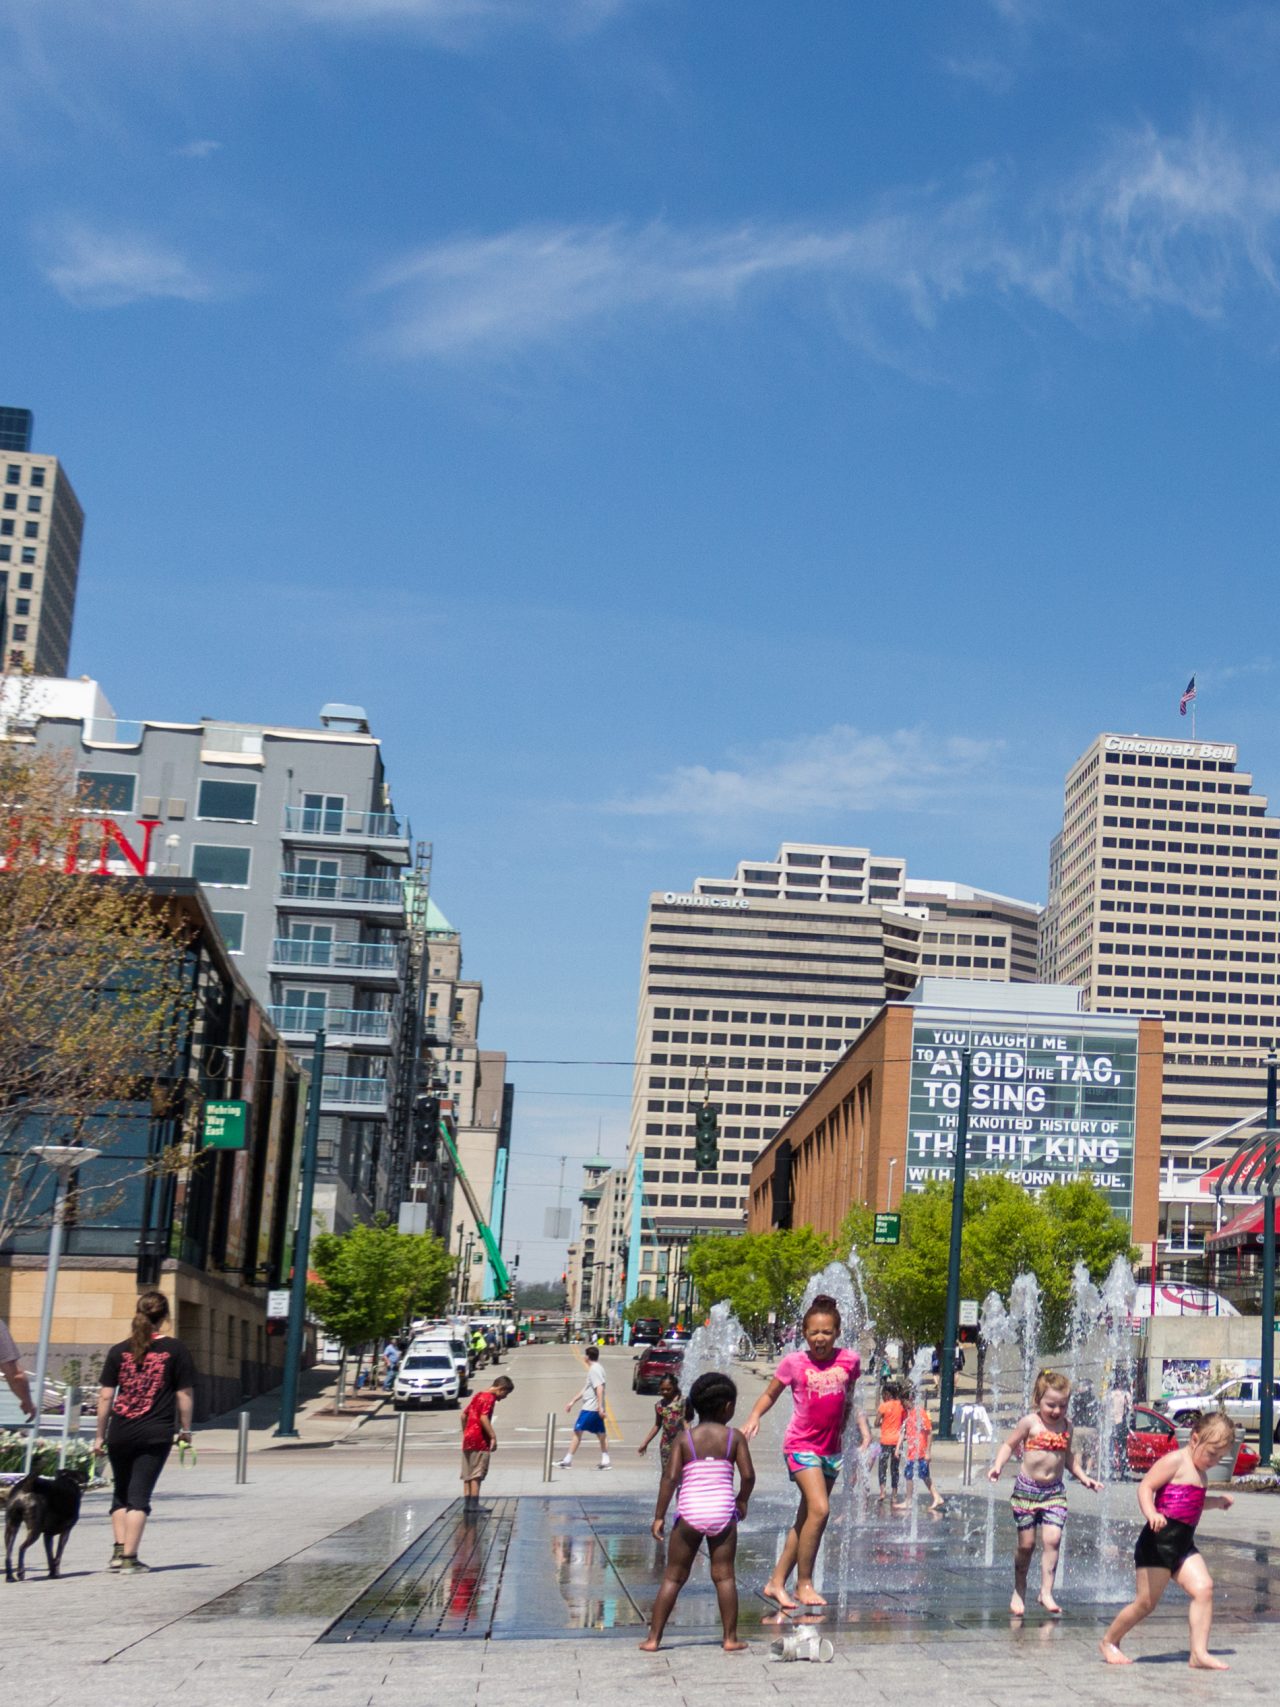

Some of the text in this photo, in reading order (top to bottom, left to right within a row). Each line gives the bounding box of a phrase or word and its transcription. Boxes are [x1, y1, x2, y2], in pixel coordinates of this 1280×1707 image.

[1104, 736, 1234, 760] Cincinnati Bell
[664, 892, 750, 909] Omnicare
[932, 1030, 1068, 1050] YOU TAUGHT ME
[916, 1049, 934, 1061] TO
[930, 1049, 1024, 1079] AVOID
[1027, 1067, 1055, 1080] THE
[923, 1081, 1046, 1112] TO SING
[207, 1105, 241, 1116] Mehring
[205, 1126, 224, 1135] East
[207, 1116, 225, 1126] Way
[969, 1116, 1033, 1130] KNOTTED
[1040, 1120, 1098, 1133] HISTORY
[1101, 1122, 1119, 1134] OF
[986, 1134, 1036, 1160] HIT
[1045, 1137, 1120, 1164] KING
